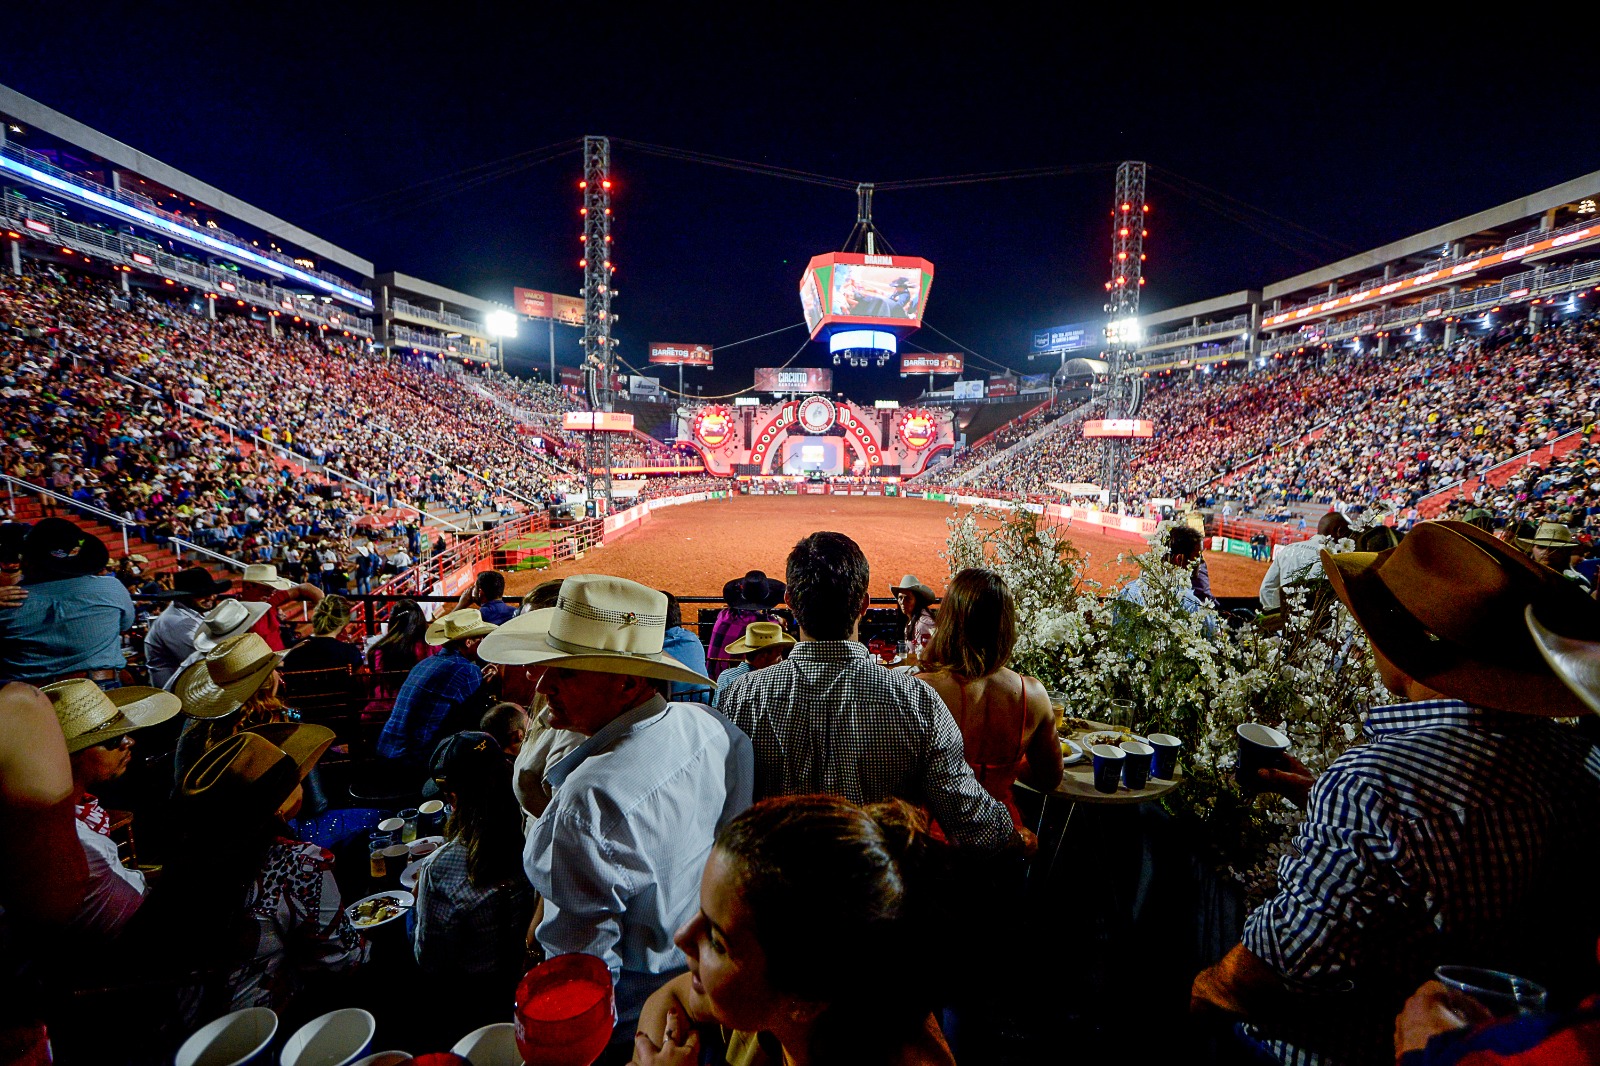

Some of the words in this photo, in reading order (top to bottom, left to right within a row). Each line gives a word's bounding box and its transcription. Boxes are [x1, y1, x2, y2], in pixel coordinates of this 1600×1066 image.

[864, 255, 893, 265] BRAHMA
[652, 349, 689, 358] BARRETOS
[903, 359, 940, 367] BARRETOS
[778, 372, 808, 383] CIRCUITO
